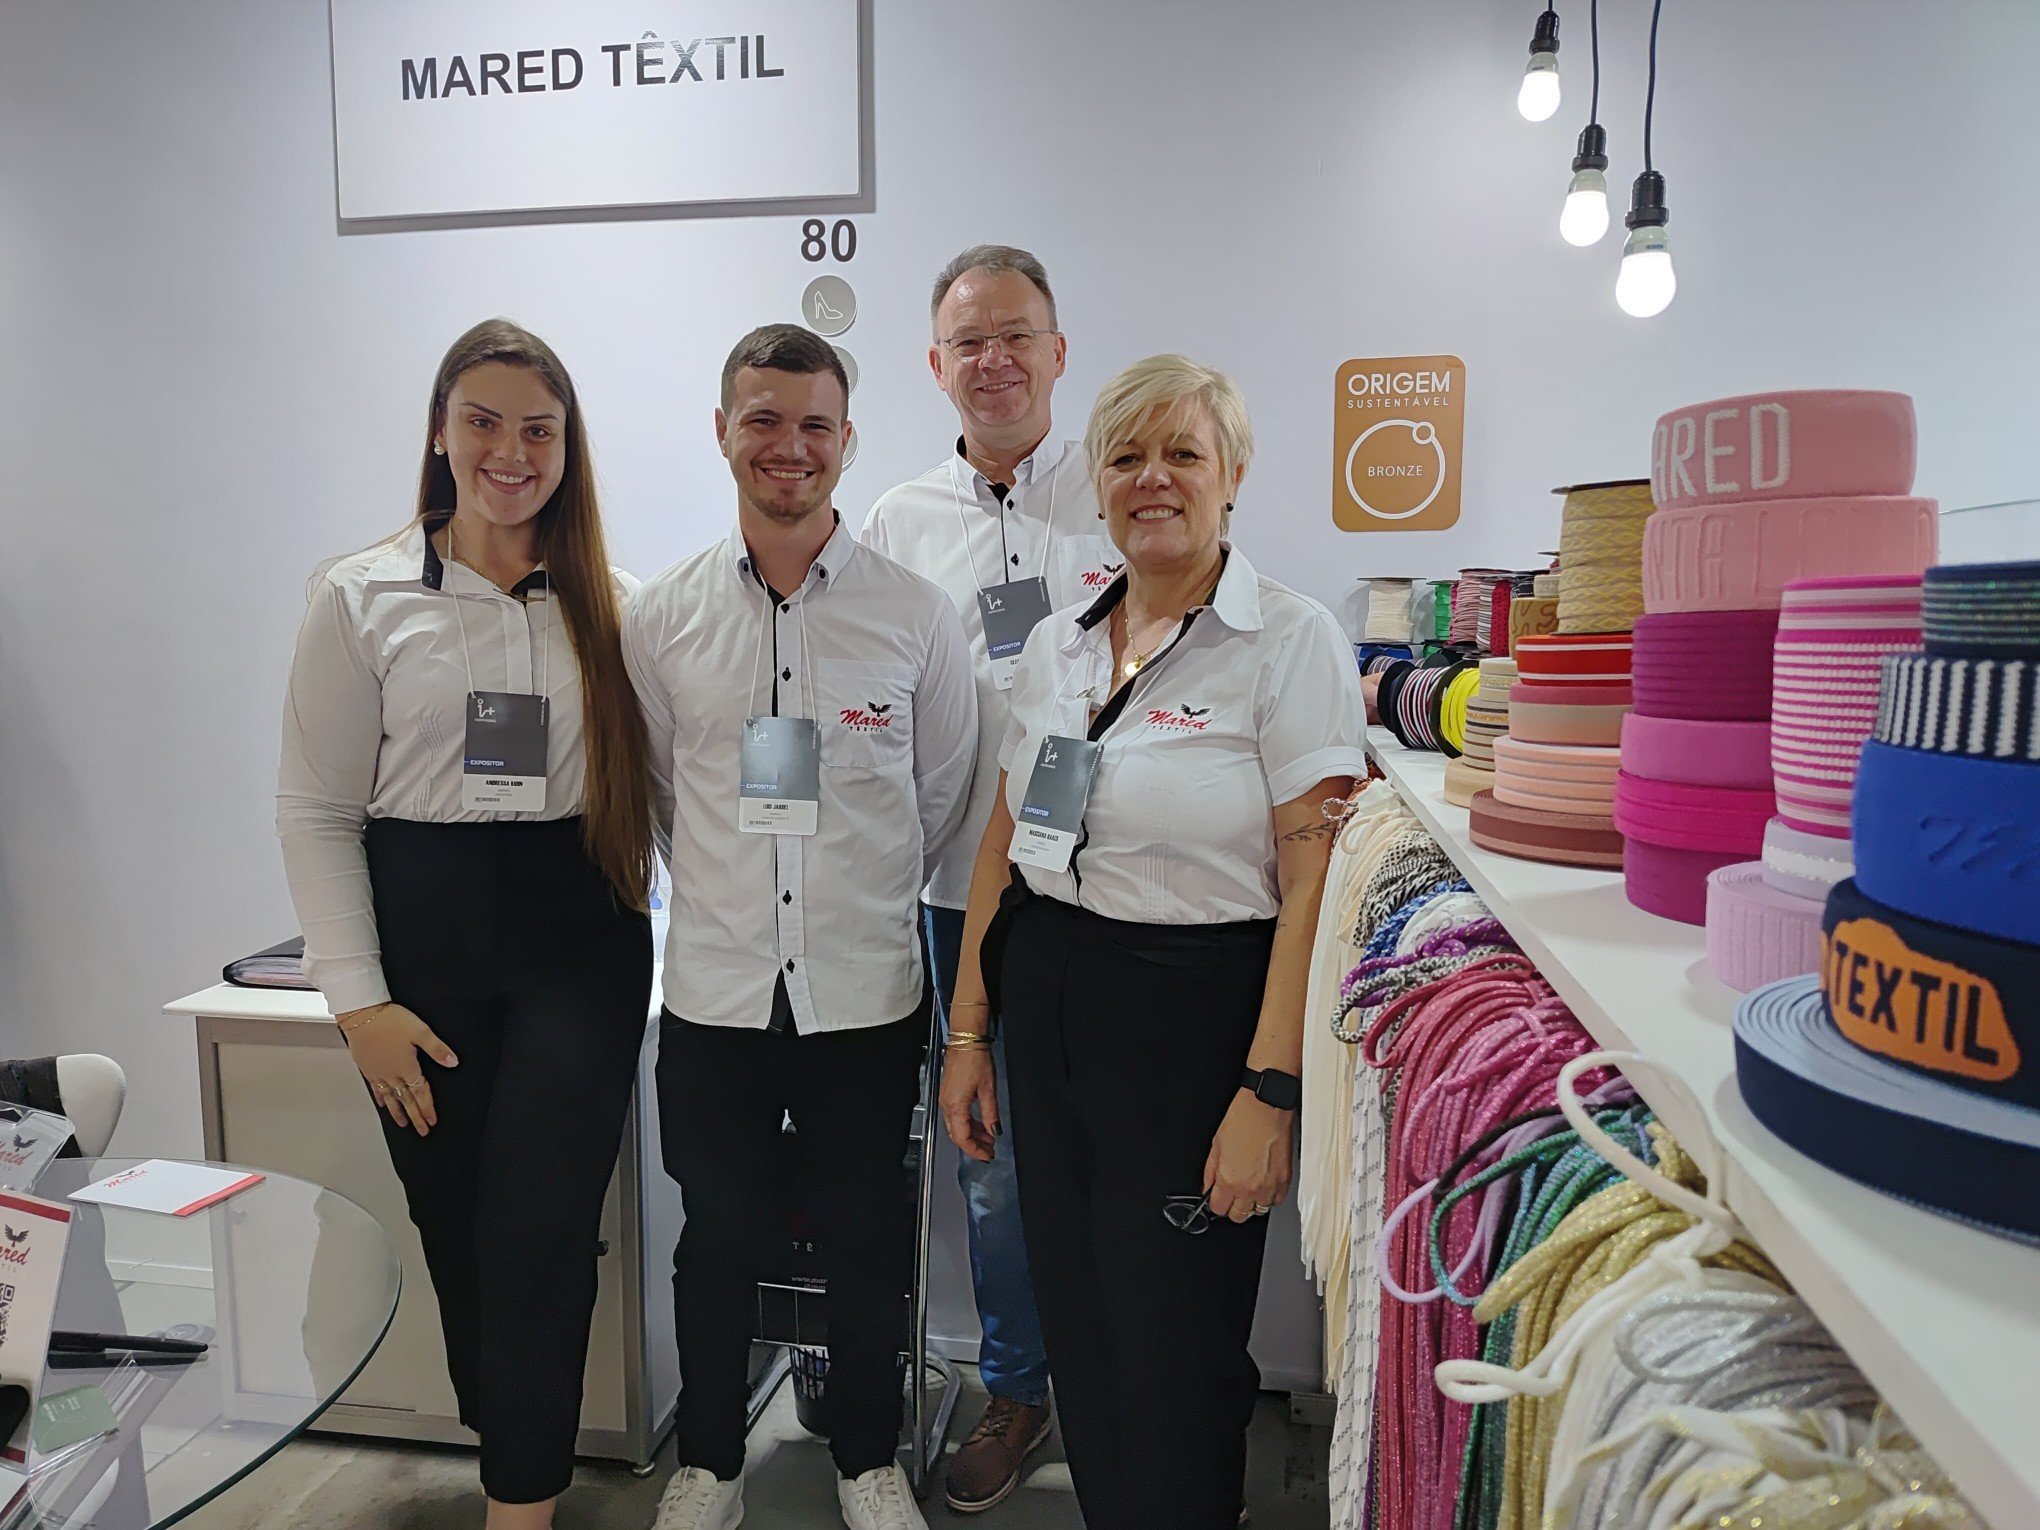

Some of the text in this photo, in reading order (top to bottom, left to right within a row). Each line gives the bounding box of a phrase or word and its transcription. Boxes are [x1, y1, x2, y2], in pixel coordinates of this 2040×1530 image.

[401, 30, 785, 100] MARED TÊXTIL
[801, 218, 857, 262] 80
[1348, 371, 1450, 396] ORIGEM
[1347, 396, 1449, 408] SUSTENTÁVEL
[1368, 465, 1423, 477] BRONZE
[993, 641, 1021, 652] EXPOSITOR
[840, 709, 895, 728] Mared
[1145, 709, 1213, 731] Mared
[470, 759, 505, 768] EXPOSITOR
[746, 783, 778, 791] EXPOSITOR
[1024, 806, 1050, 817] EXPOSITOR
[1835, 939, 1999, 1066] TEXTIL
